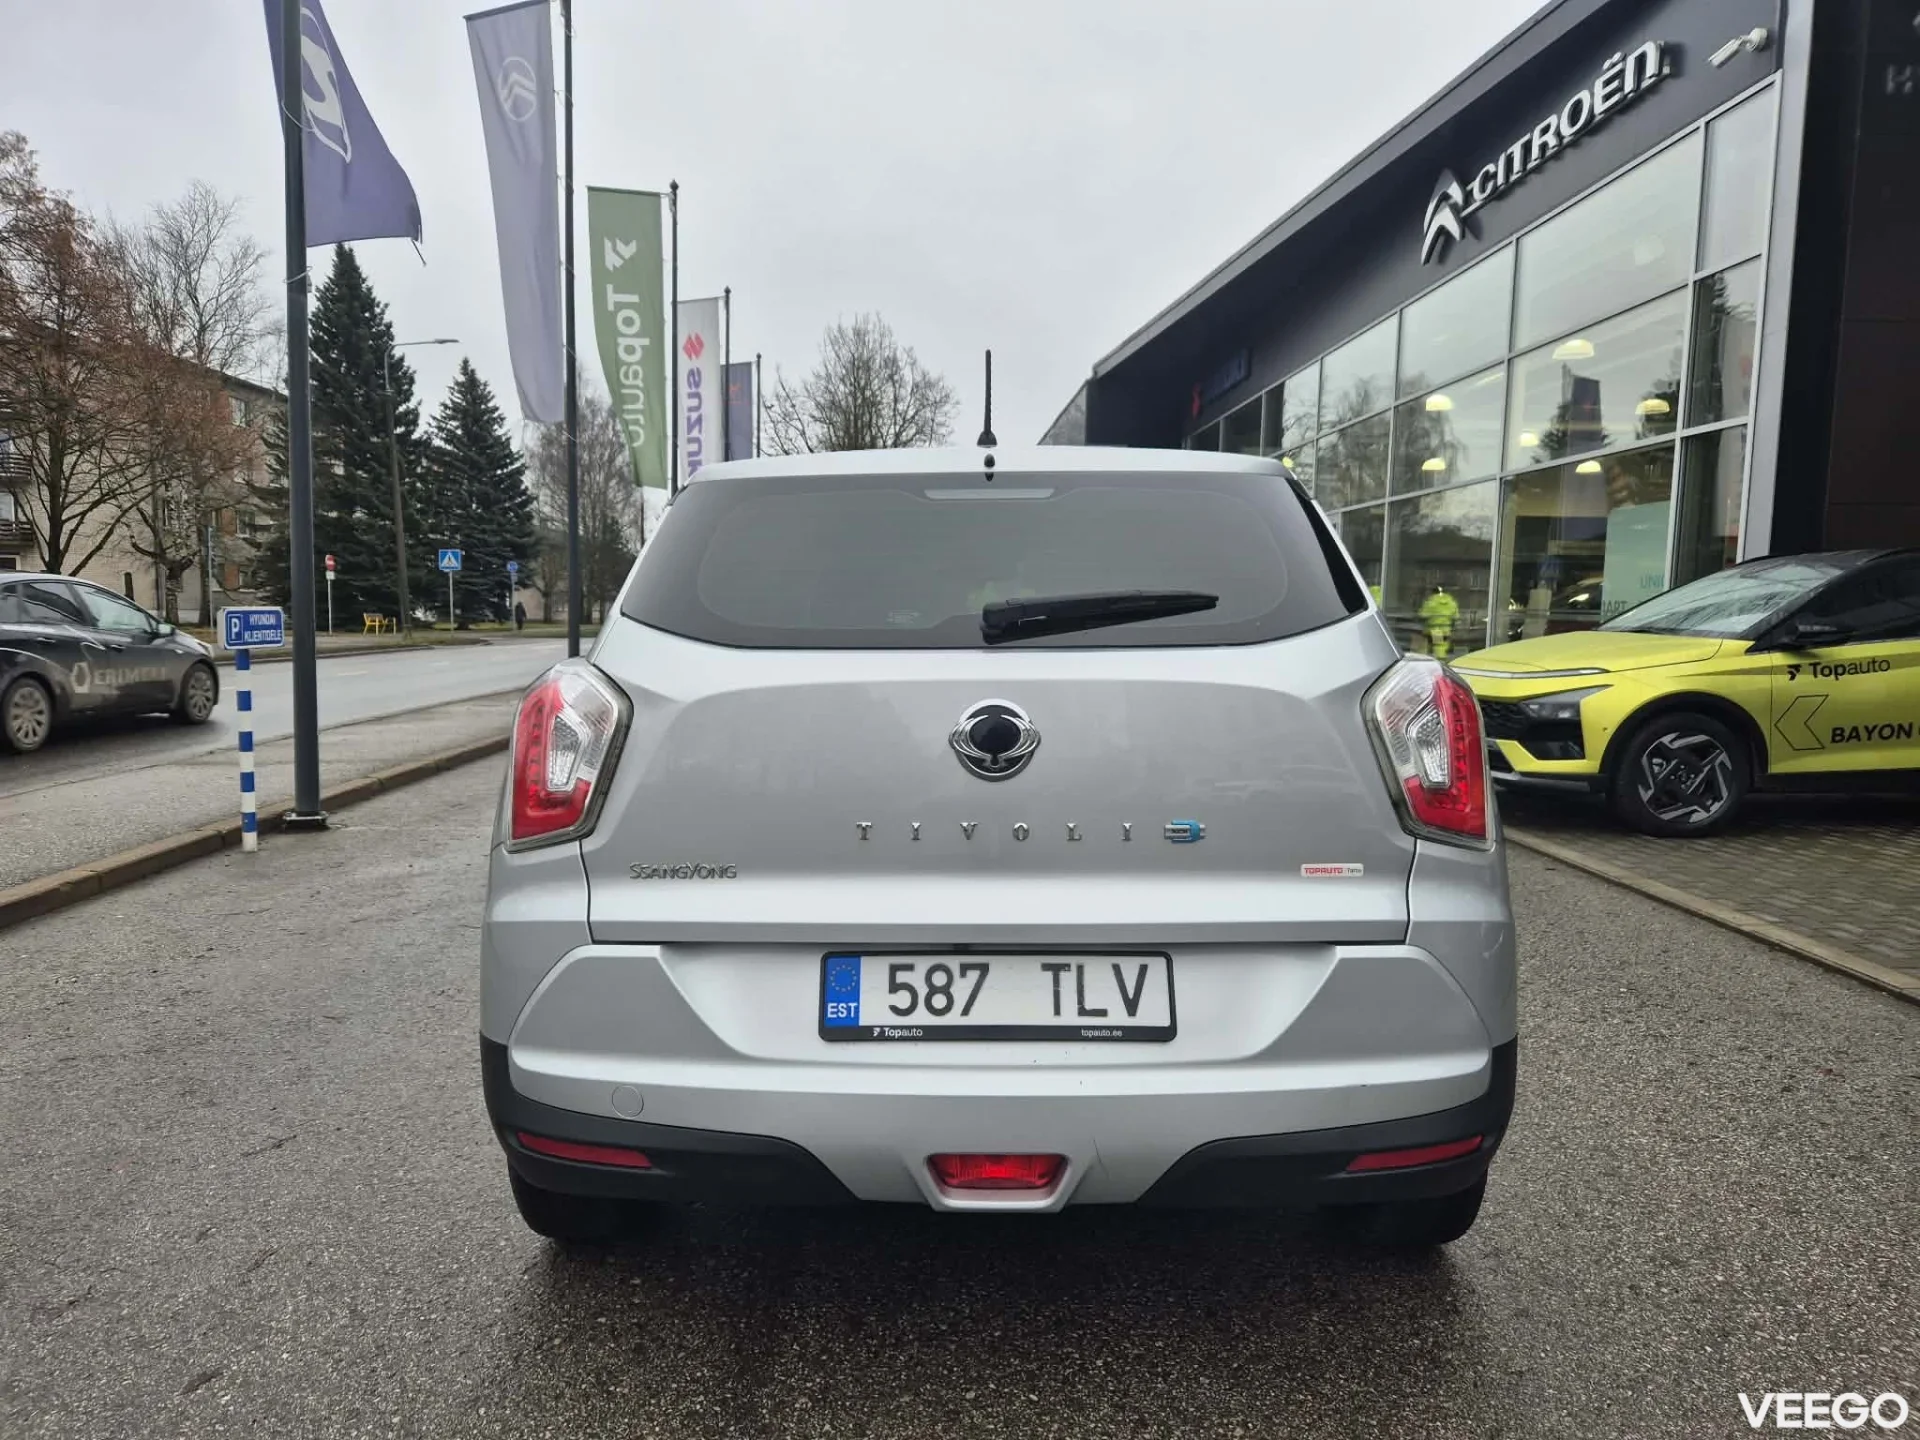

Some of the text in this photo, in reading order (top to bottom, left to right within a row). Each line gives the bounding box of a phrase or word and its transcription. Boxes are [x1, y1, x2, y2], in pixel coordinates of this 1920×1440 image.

[231, 618, 240, 640] P
[249, 613, 276, 626] HYUNDAI
[1808, 657, 1891, 681] Topauto
[1830, 721, 1914, 744] BAYON
[855, 821, 1134, 842] TIVOLI
[1304, 867, 1343, 875] TOPAUTO
[888, 963, 1149, 1018] 587 TLV
[827, 1003, 858, 1018] EST
[883, 1027, 1123, 1038] Topauto topauto.ee
